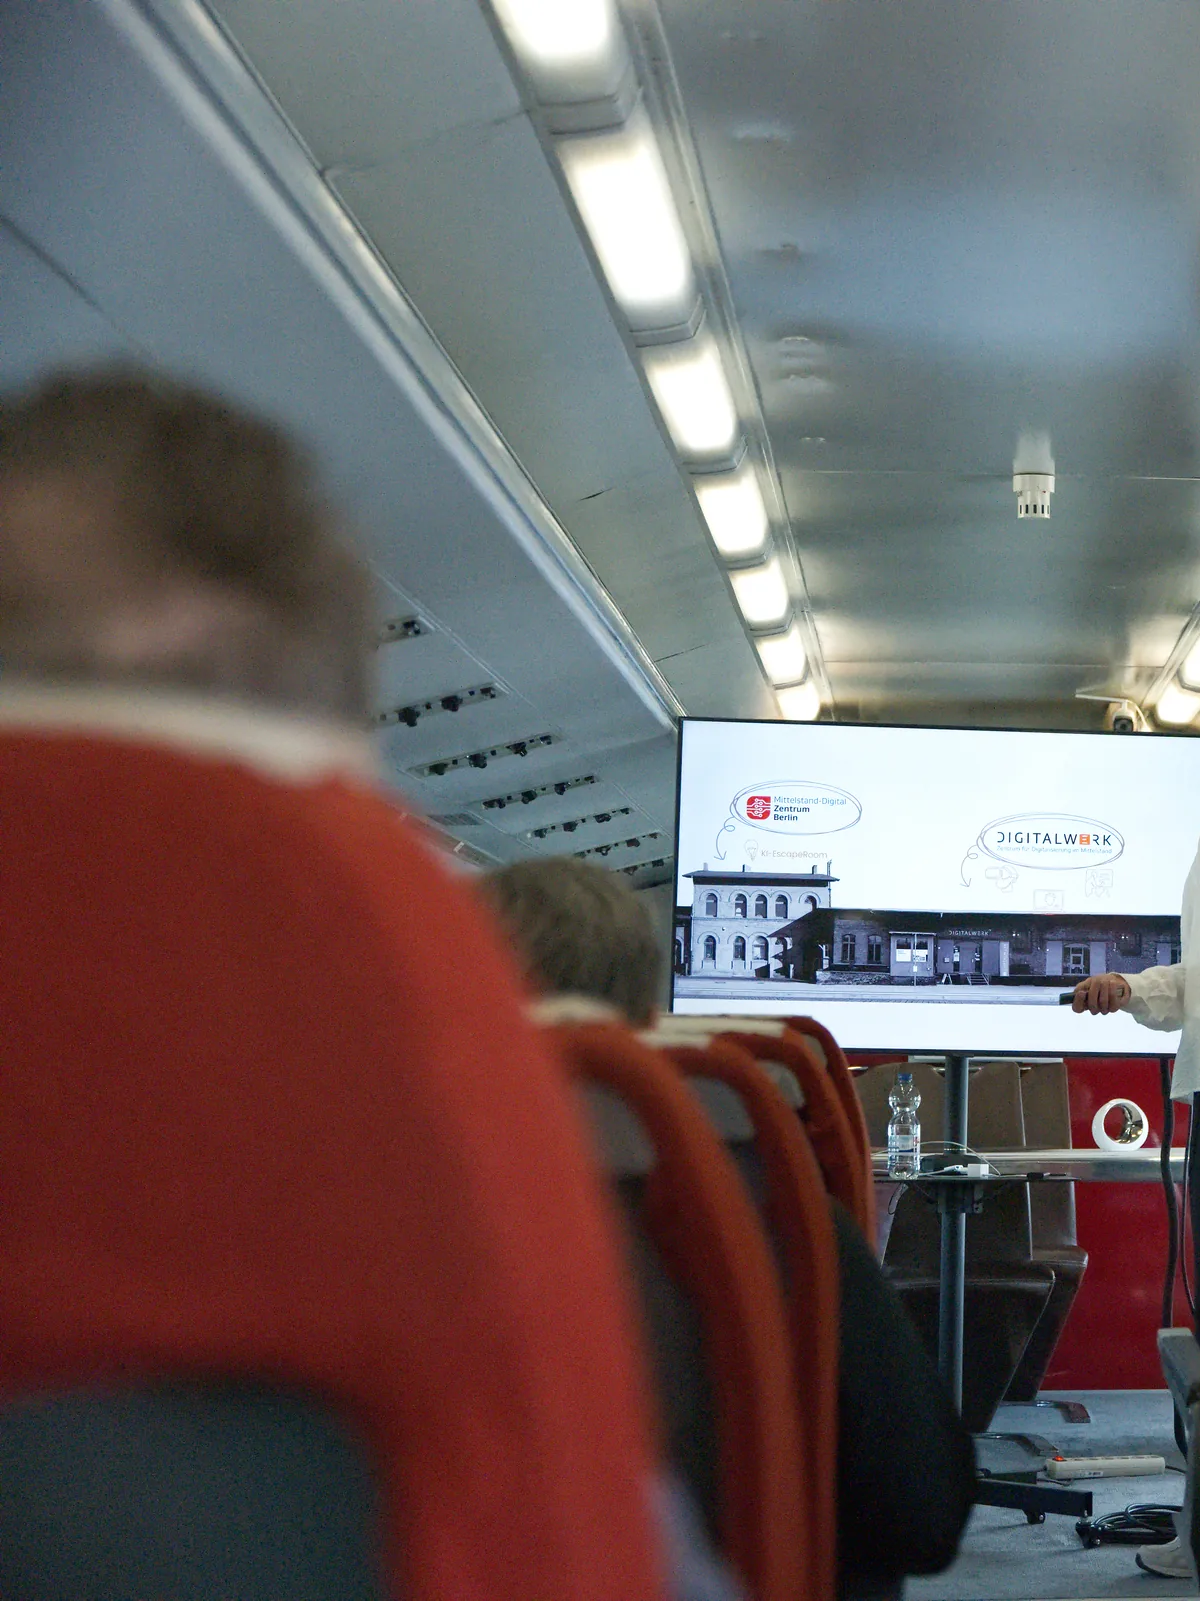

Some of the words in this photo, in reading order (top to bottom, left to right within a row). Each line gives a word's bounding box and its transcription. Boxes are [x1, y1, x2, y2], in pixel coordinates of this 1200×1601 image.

[773, 796, 847, 806] Mittelstand-Digital
[773, 804, 811, 813] Zentrum
[773, 813, 799, 821] Berlin
[997, 831, 1112, 846] DIGITALWERK
